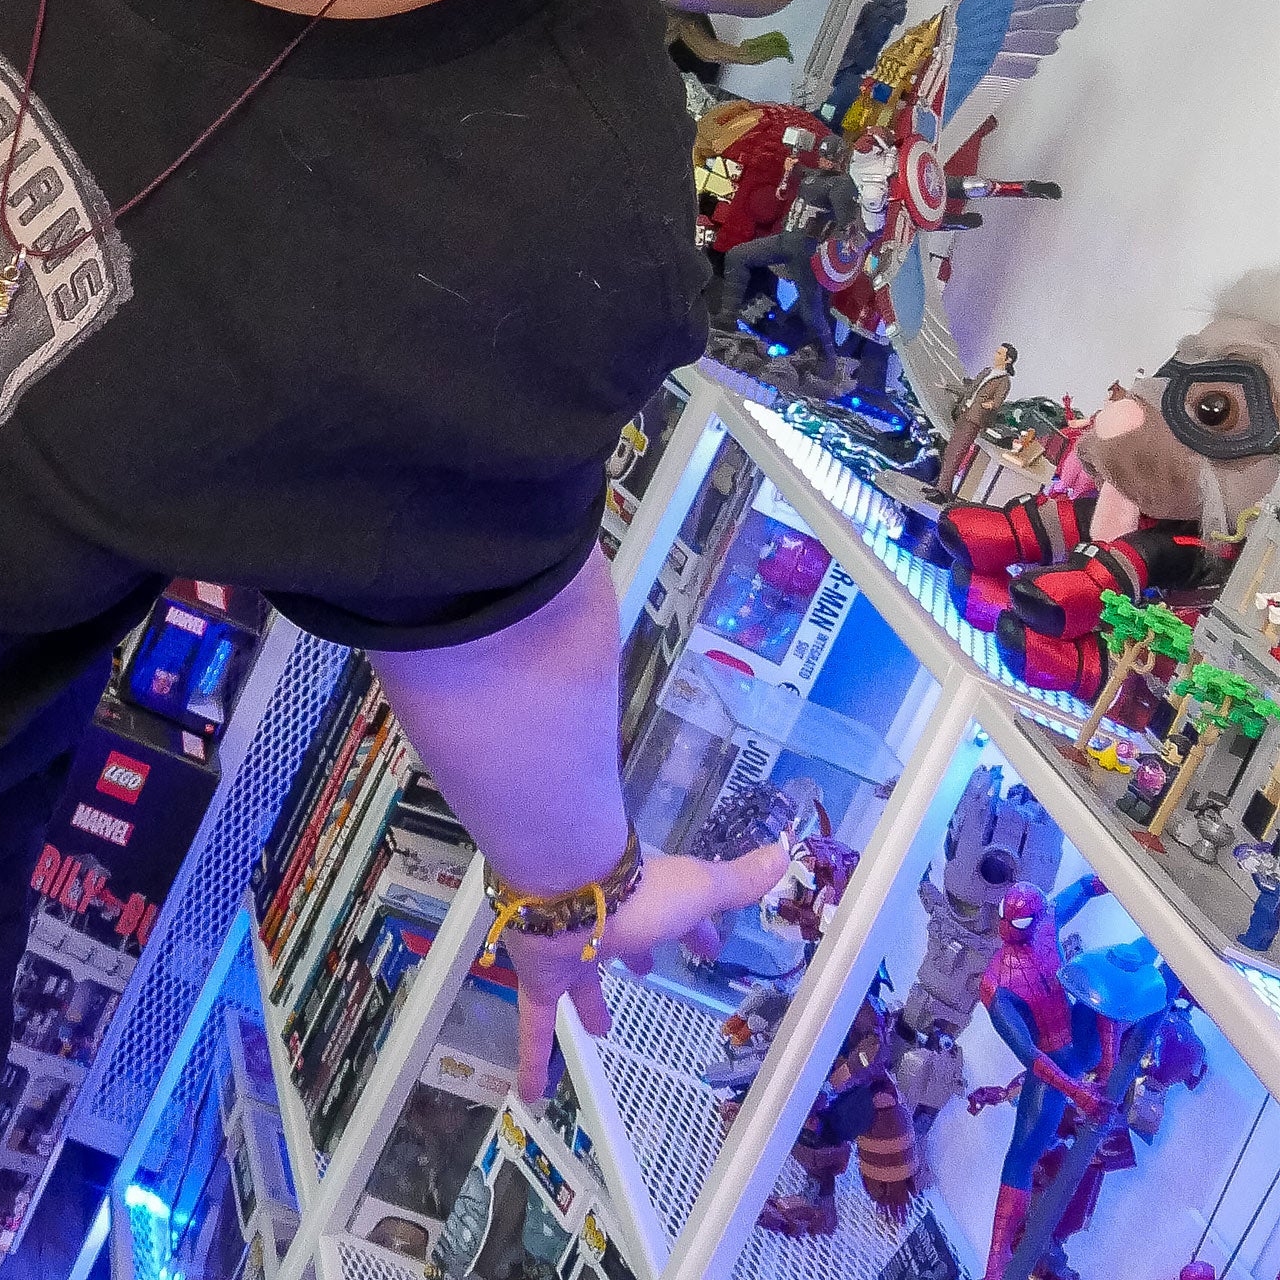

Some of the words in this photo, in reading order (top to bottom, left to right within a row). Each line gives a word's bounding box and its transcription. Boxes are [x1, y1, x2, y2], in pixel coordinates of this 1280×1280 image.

[808, 563, 854, 633] R-MAN
[103, 763, 143, 791] LEGO
[71, 802, 129, 846] MARVEL
[31, 842, 106, 913] AILY
